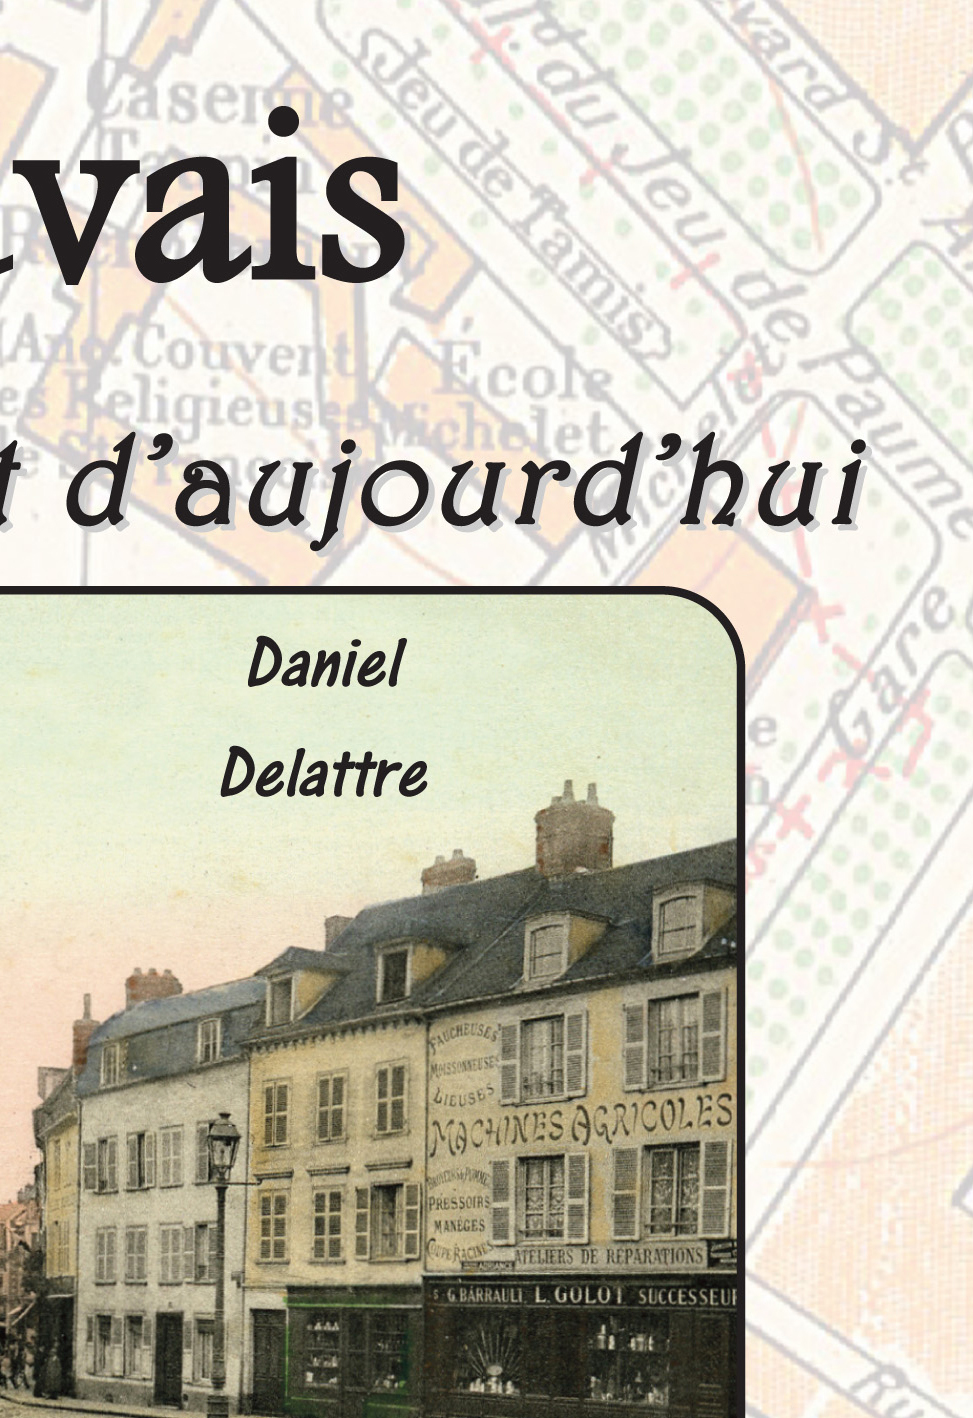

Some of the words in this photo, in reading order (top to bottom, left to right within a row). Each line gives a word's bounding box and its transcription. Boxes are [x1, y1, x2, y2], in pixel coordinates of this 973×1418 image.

[133, 321, 358, 377] Couvent
[429, 1022, 499, 1055] FAUCHEUSES
[432, 1082, 495, 1108] LIEUSES
[429, 1110, 565, 1158] MACHINES
[570, 1092, 733, 1146] AGRICOLES
[515, 1247, 574, 1267] ATELIERS
[580, 1247, 599, 1265] DE
